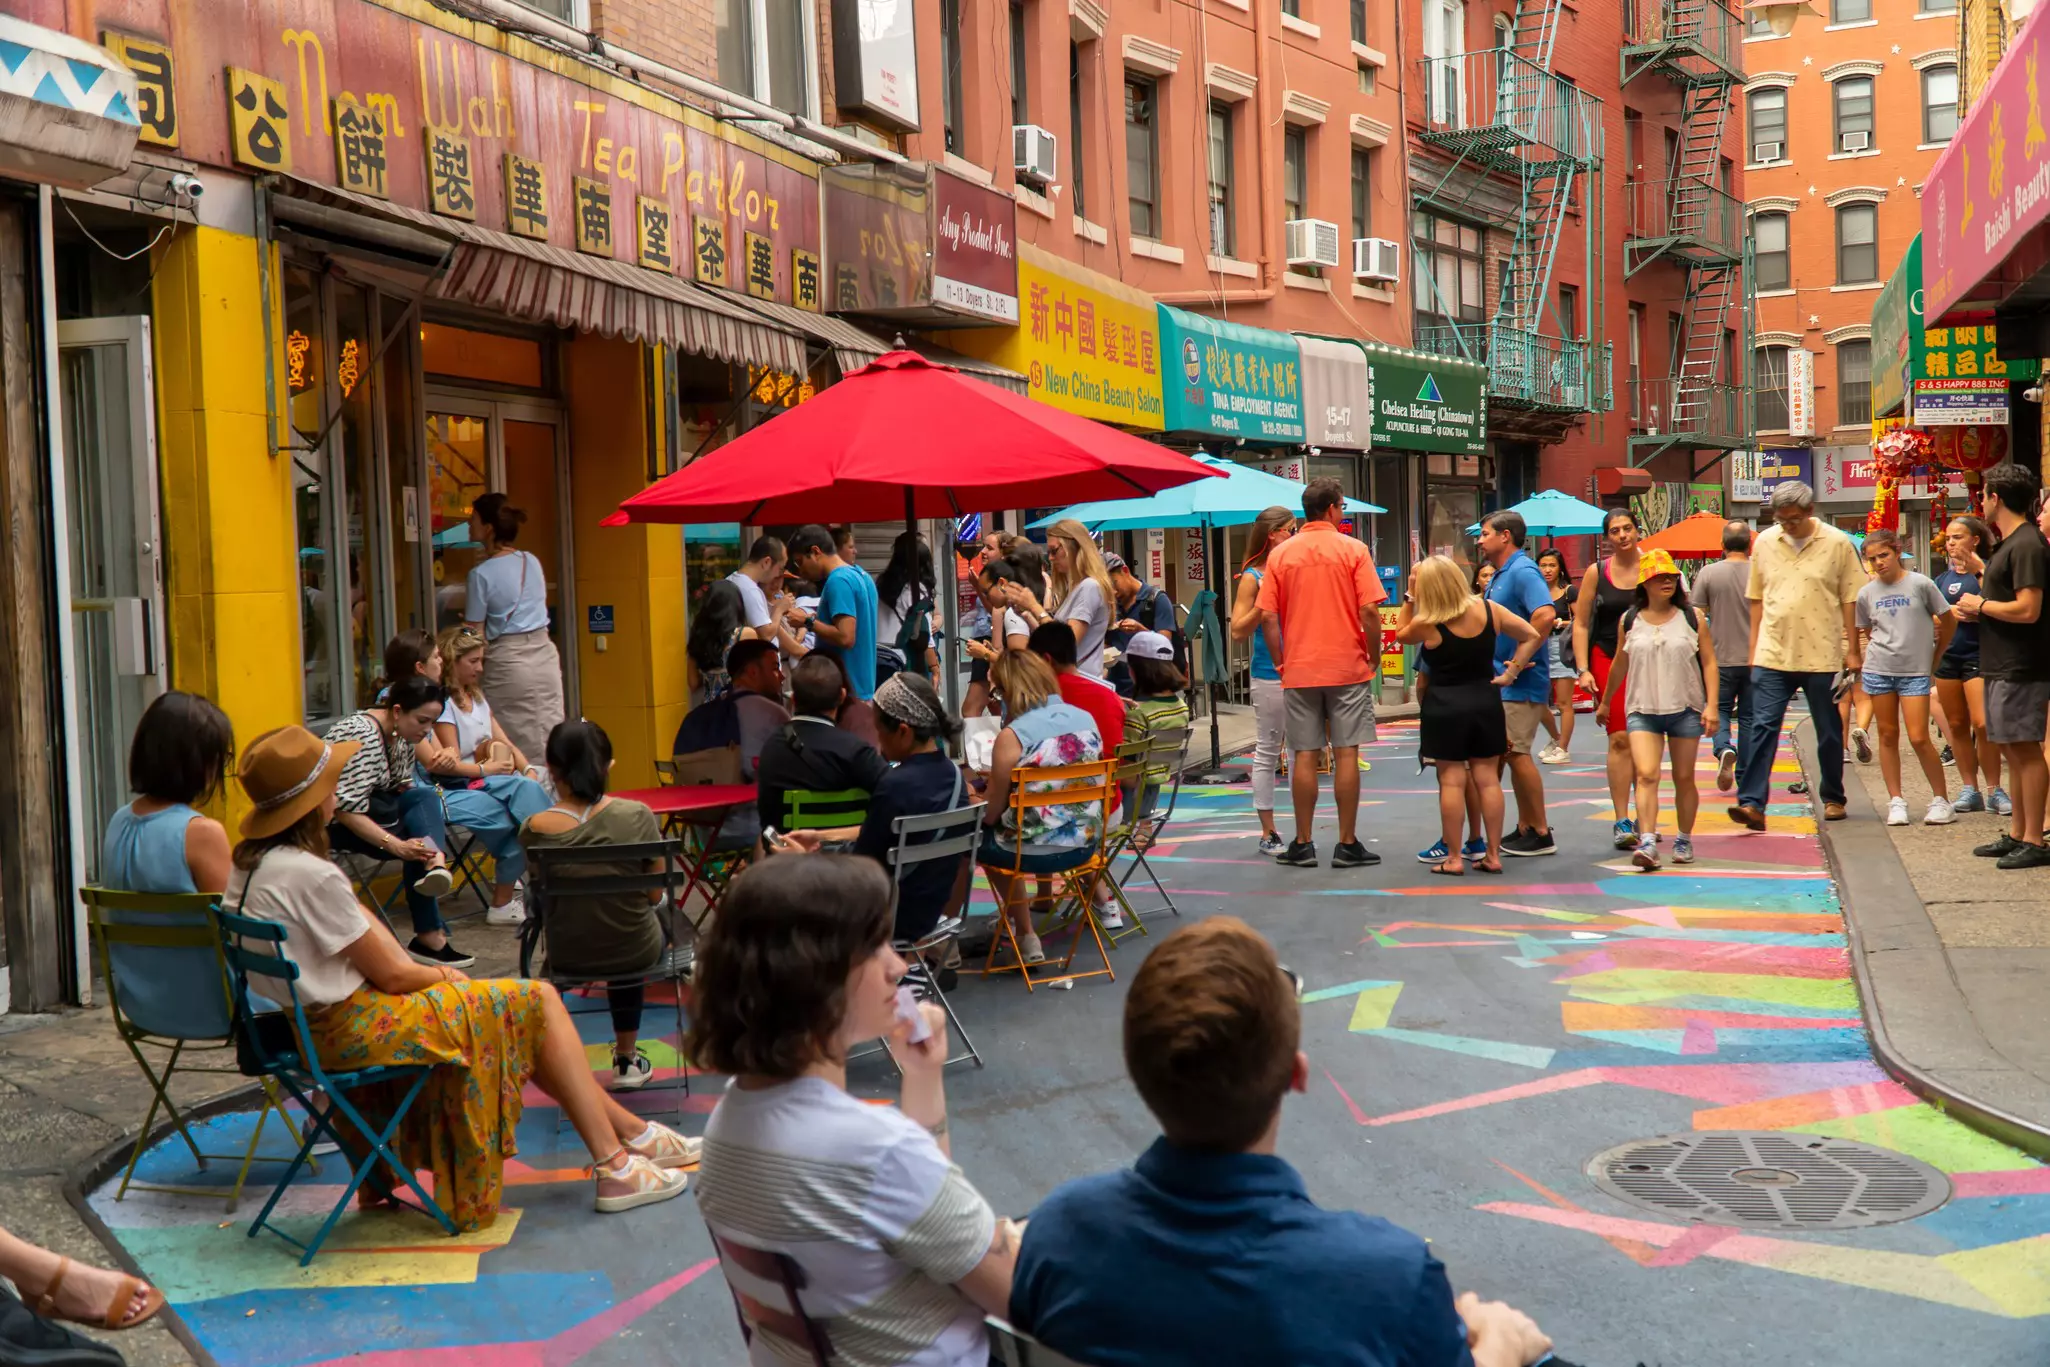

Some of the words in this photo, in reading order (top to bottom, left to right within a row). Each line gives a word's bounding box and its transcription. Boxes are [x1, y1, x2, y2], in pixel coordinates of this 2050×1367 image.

[282, 28, 405, 138] Nm
[418, 37, 515, 139] Wah
[574, 101, 637, 182] Tea
[661, 133, 779, 231] Parlor
[1984, 196, 2012, 254] Baishi
[2014, 160, 2050, 222] Beauty
[940, 204, 960, 252] Any
[962, 211, 993, 252] Product
[995, 223, 1012, 259] Inc.
[965, 287, 983, 309] Doyers
[1045, 363, 1069, 396] New
[1071, 371, 1100, 403] China
[1103, 378, 1135, 415] Beauty
[1137, 386, 1161, 415] Salon
[1988, 380, 2006, 388] INC
[1212, 391, 1229, 411] TINA
[1230, 395, 1272, 417] EMPLOYMENT
[1273, 402, 1298, 420] AGENCY
[1325, 406, 1351, 426] 15-17
[1381, 399, 1408, 417] Chelsea
[1409, 403, 1436, 425] Healing
[1438, 406, 1475, 426] (Chinatown)
[1325, 431, 1345, 446] Doyers
[1346, 433, 1354, 443] St.
[1386, 420, 1415, 433] ACUPUNCTURE
[1823, 452, 1838, 496] 美容
[1875, 597, 1911, 610] PENN
